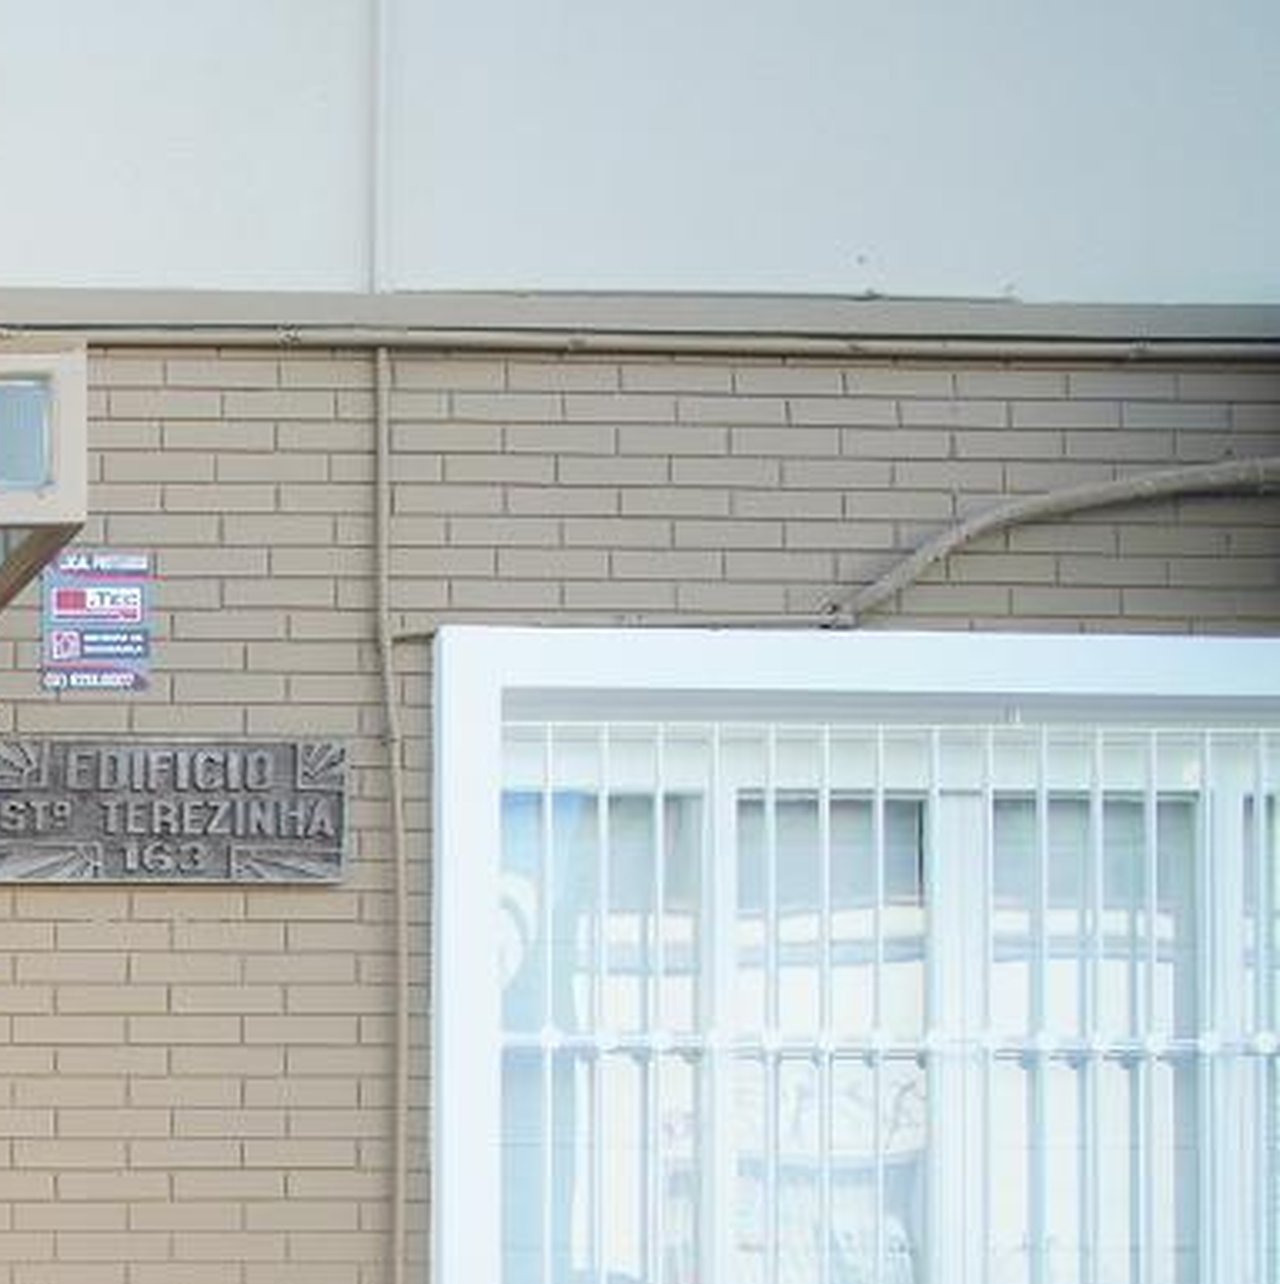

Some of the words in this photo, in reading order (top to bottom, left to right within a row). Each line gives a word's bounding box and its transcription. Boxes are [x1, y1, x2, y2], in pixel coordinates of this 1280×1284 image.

[66, 750, 276, 791] EDIFICIO
[101, 800, 336, 837] TEREZINHA
[120, 842, 207, 873] 163
